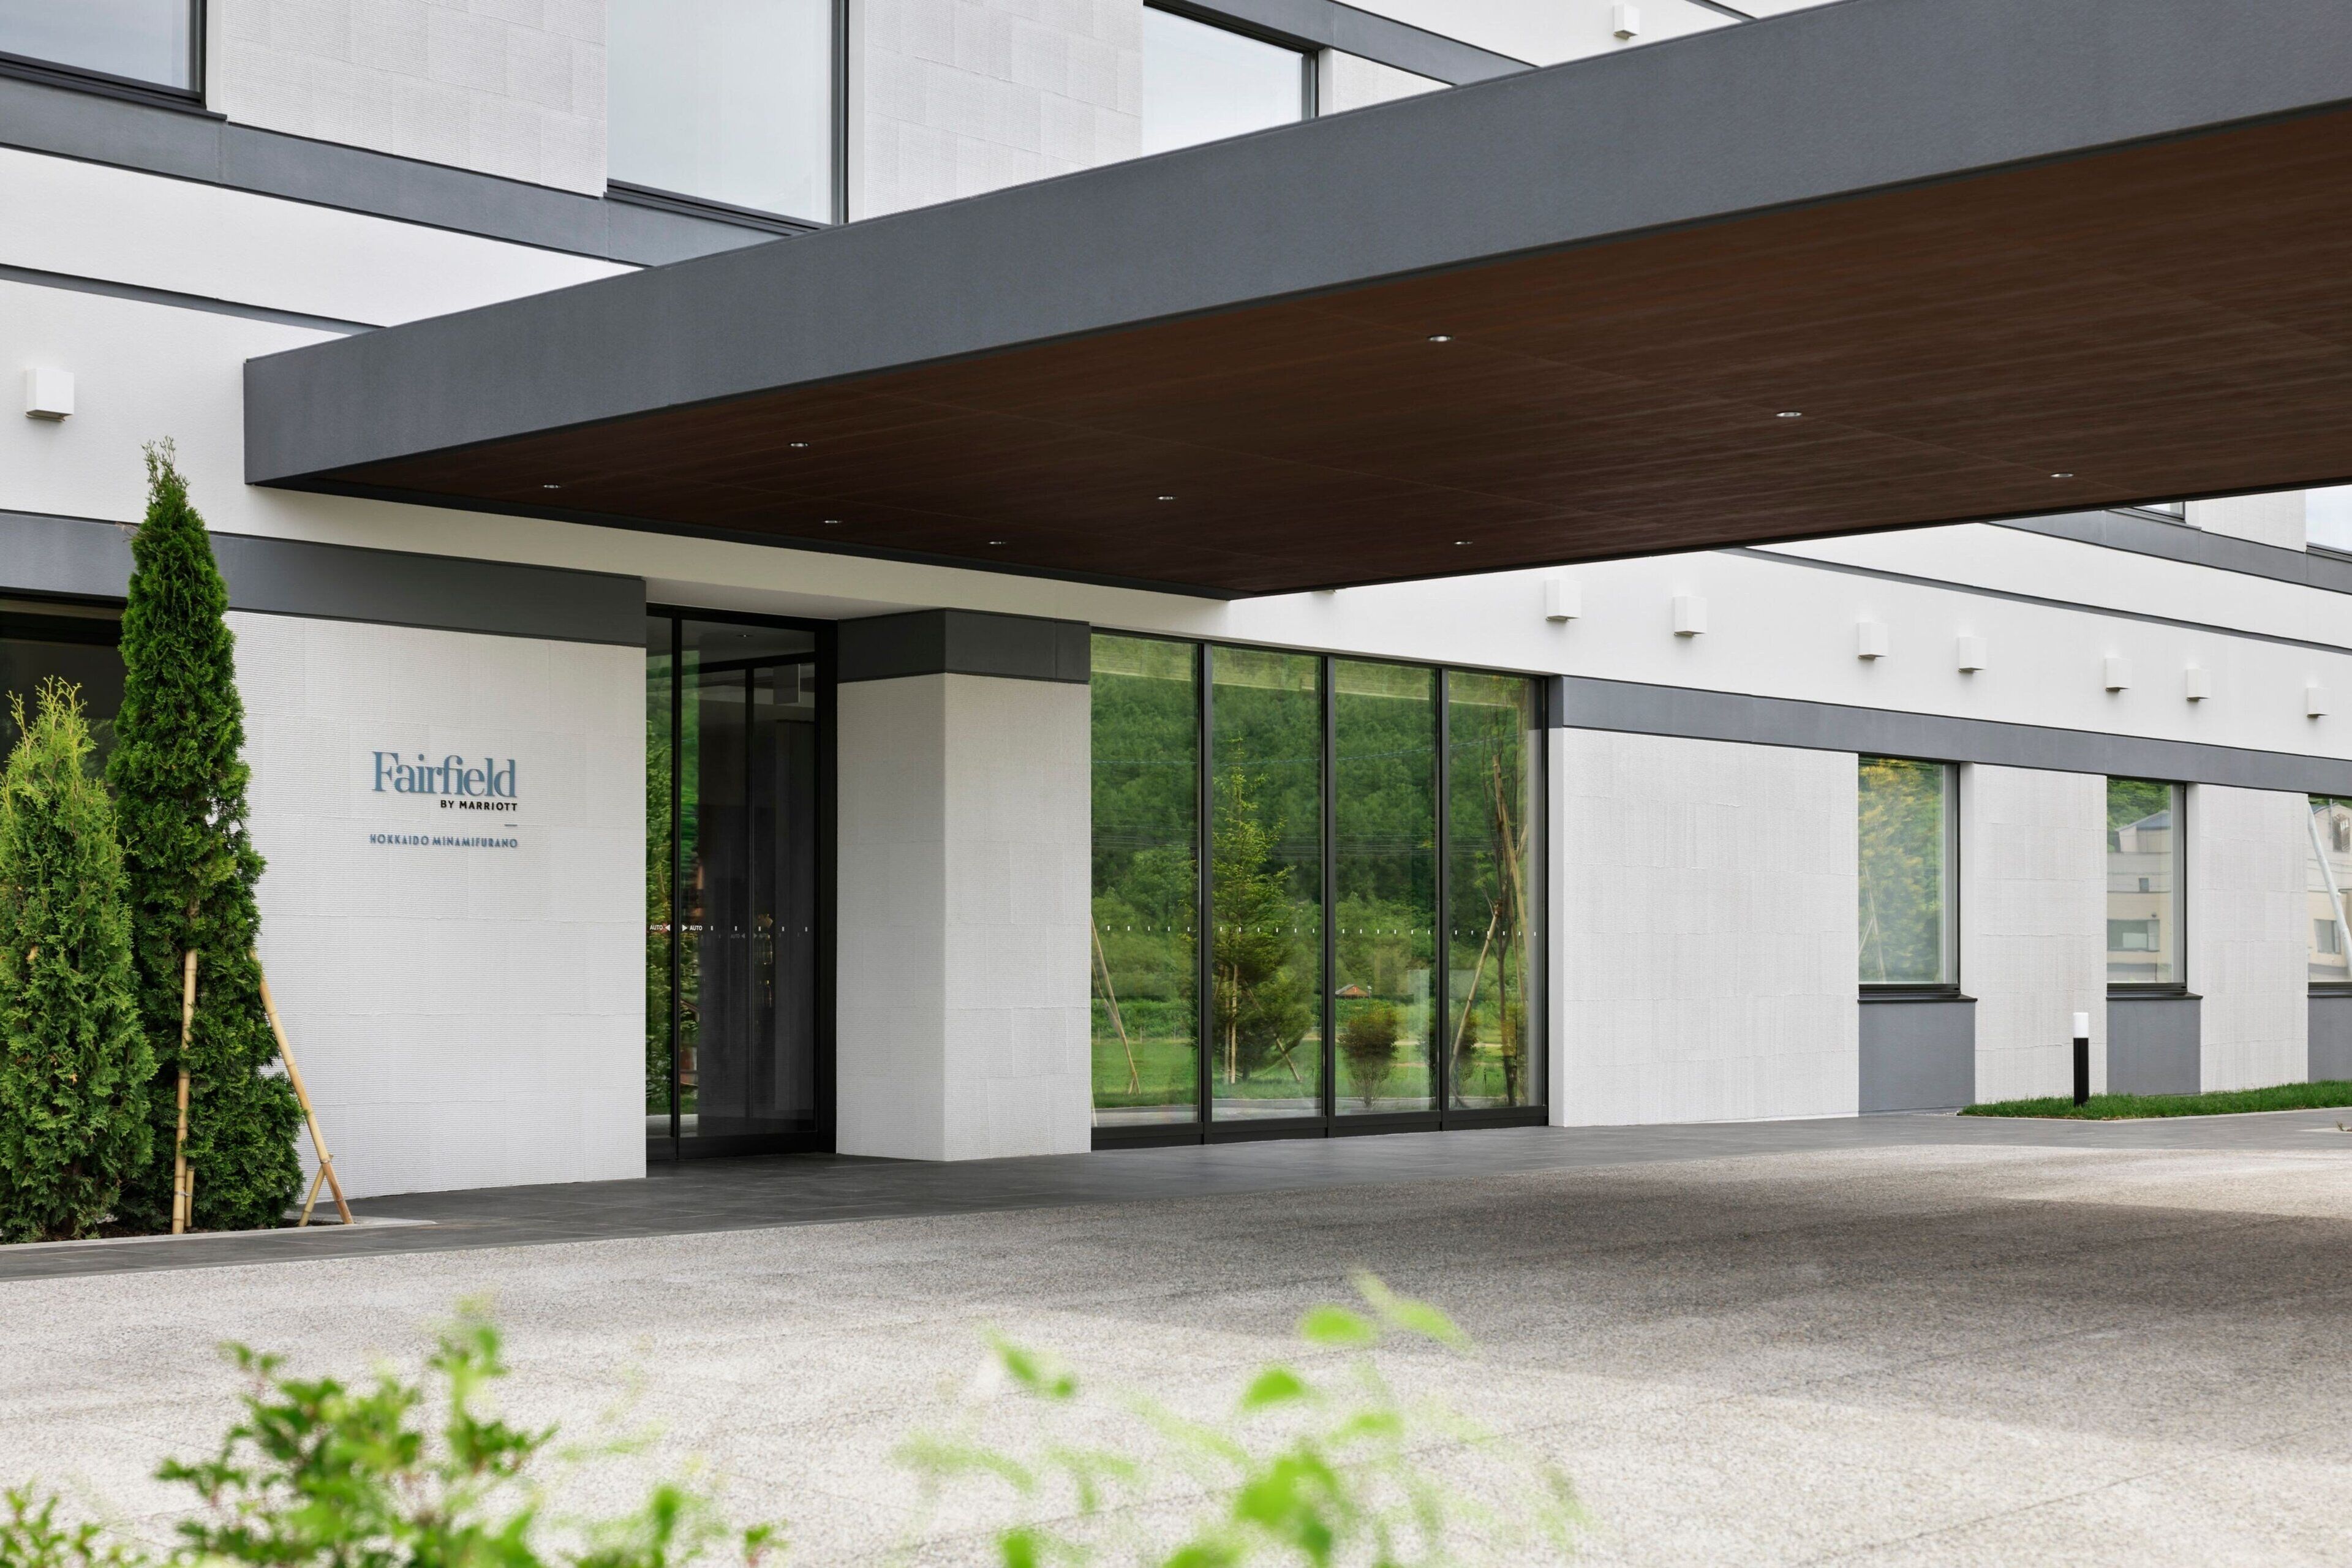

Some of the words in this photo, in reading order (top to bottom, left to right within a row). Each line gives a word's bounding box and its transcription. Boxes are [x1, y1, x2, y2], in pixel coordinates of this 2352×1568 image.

[372, 751, 517, 798] Fairfield
[440, 800, 454, 809] BY
[459, 801, 518, 811] MARRIOTT
[370, 834, 429, 845] HOKKAIDO
[432, 836, 518, 848] MINAMIFURANO
